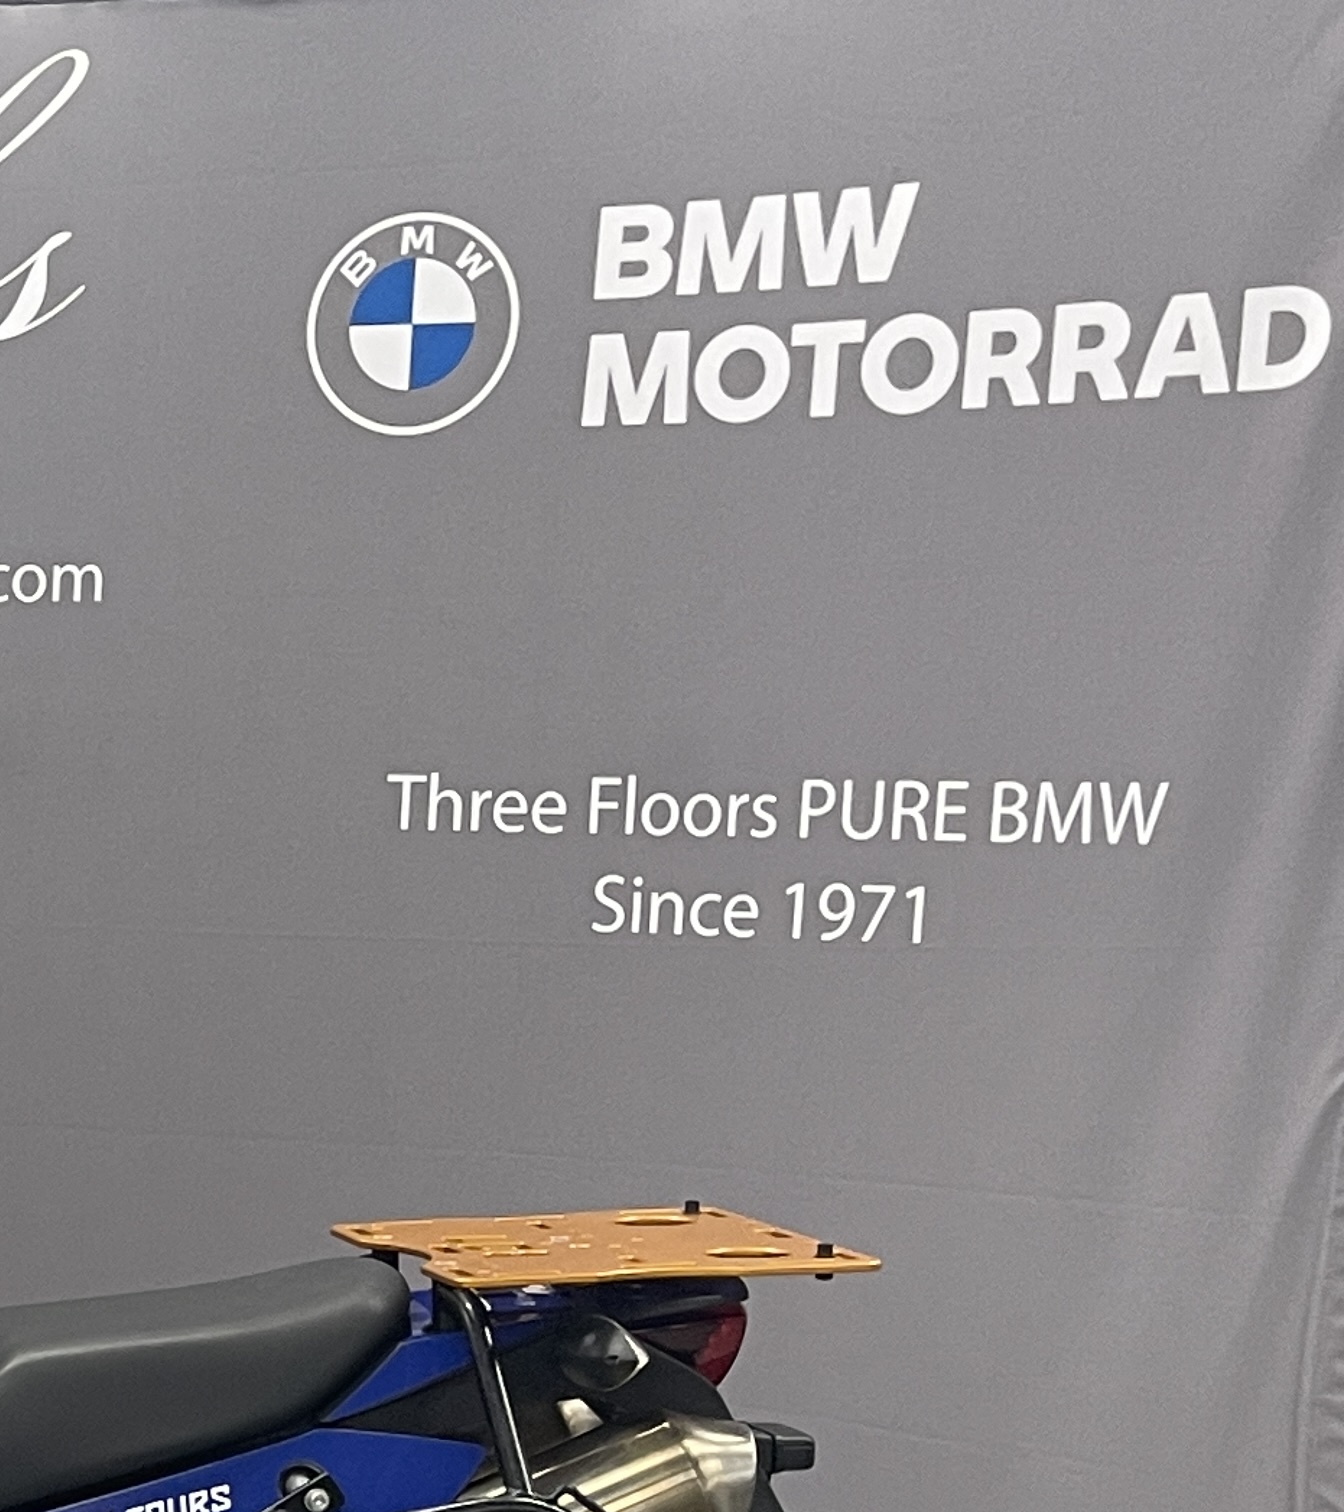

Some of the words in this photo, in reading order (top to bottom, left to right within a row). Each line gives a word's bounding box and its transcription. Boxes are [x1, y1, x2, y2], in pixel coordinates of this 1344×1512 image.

[340, 224, 493, 286] BMW
[594, 182, 920, 299] BMW
[582, 285, 1331, 426] MOTORRAD
[387, 772, 566, 833] Three
[590, 775, 776, 838] Floors
[800, 780, 969, 841] PURE
[990, 781, 1169, 845] BMW
[592, 875, 758, 937] Since
[786, 883, 924, 944] 1971
